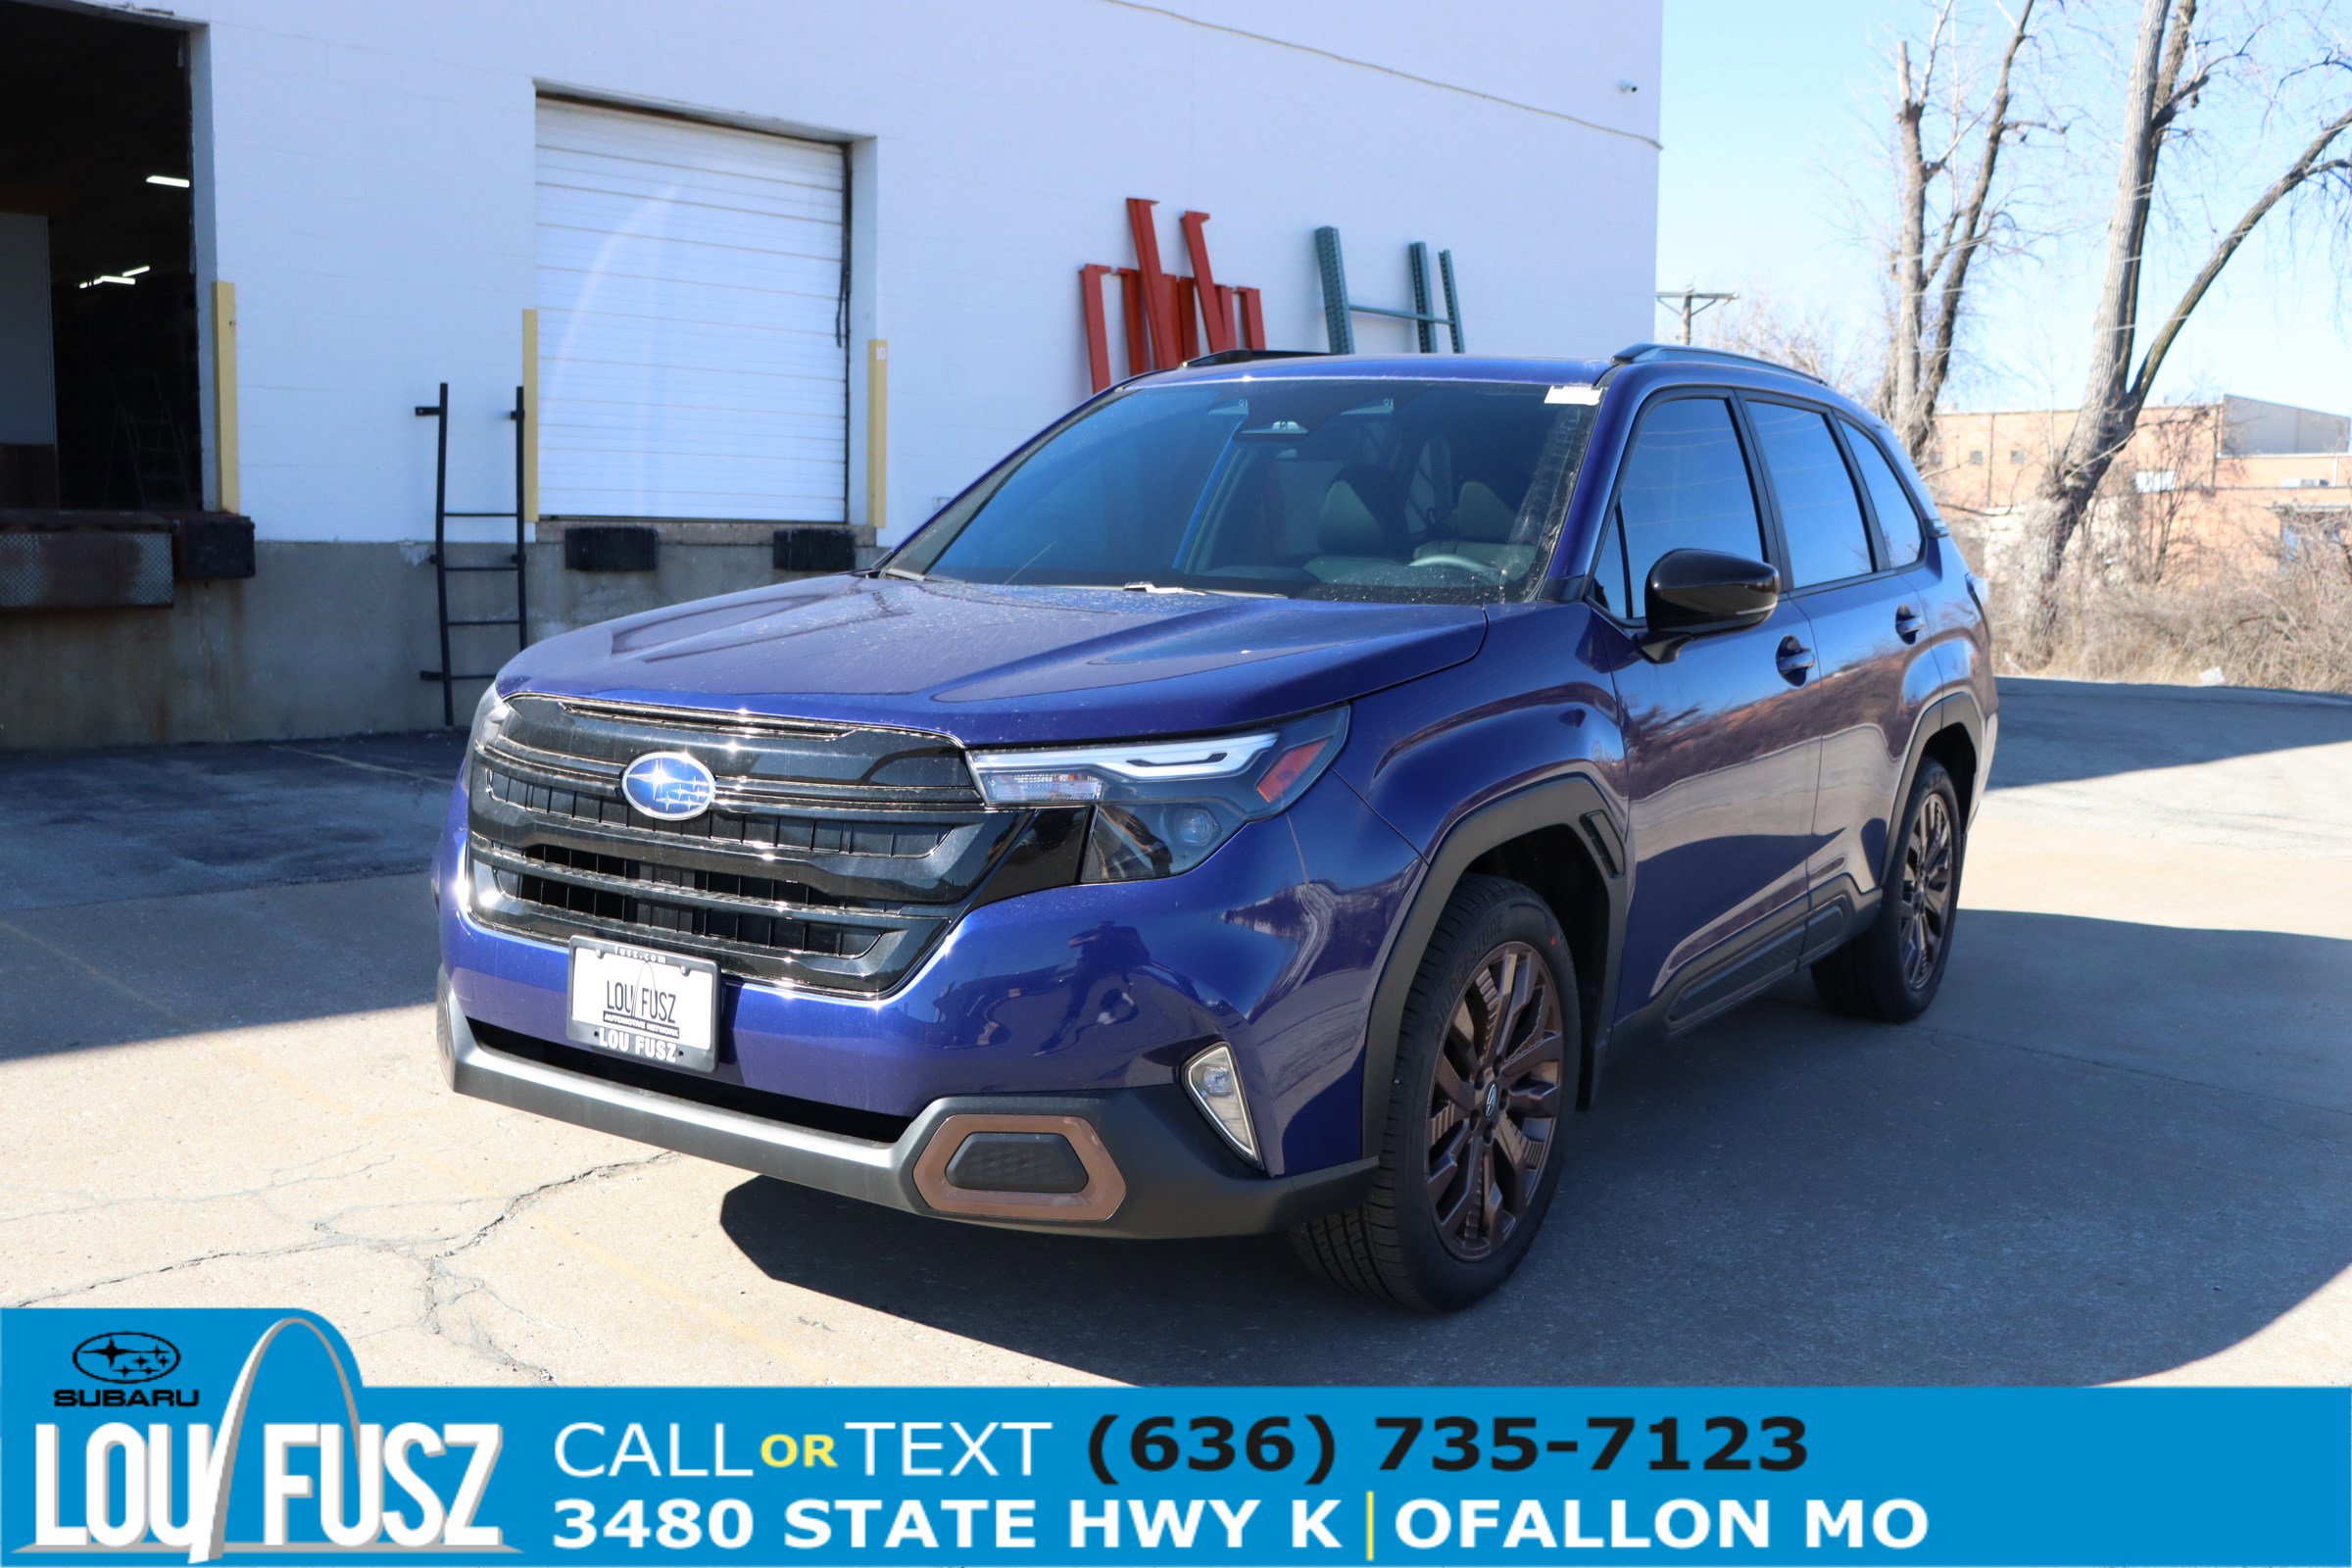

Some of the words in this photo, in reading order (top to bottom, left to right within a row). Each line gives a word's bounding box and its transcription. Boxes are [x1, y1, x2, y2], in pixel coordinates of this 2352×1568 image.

[614, 946, 666, 964] fusz.com
[607, 980, 634, 1014] LOU
[641, 987, 676, 1023] FUSZ
[604, 1013, 647, 1030] AUTOMOTIVE
[646, 1021, 679, 1038] NETWORK
[599, 1027, 630, 1053] LOU
[634, 1035, 677, 1063] FUSZ
